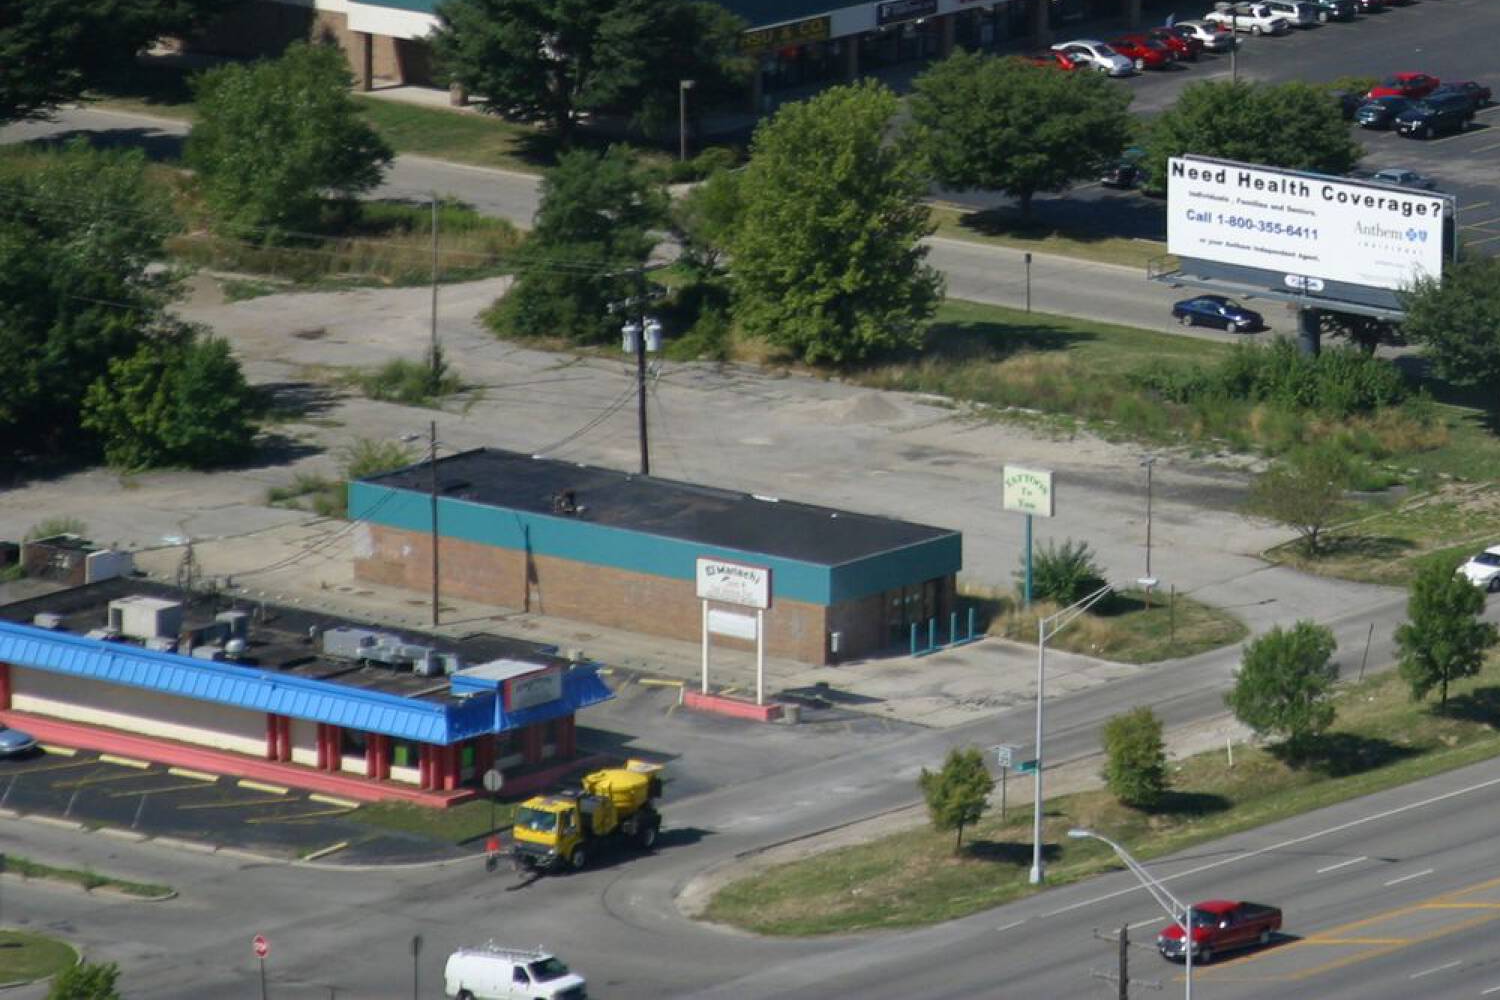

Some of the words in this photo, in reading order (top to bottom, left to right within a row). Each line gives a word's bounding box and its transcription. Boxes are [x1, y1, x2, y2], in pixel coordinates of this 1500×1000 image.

[1172, 161, 1226, 183] Need
[1238, 172, 1310, 198] Health
[1322, 185, 1442, 218] Coverage?
[1186, 208, 1213, 224] Call
[1218, 213, 1318, 240] 1-800-355-6411
[1355, 220, 1402, 240] Anthem
